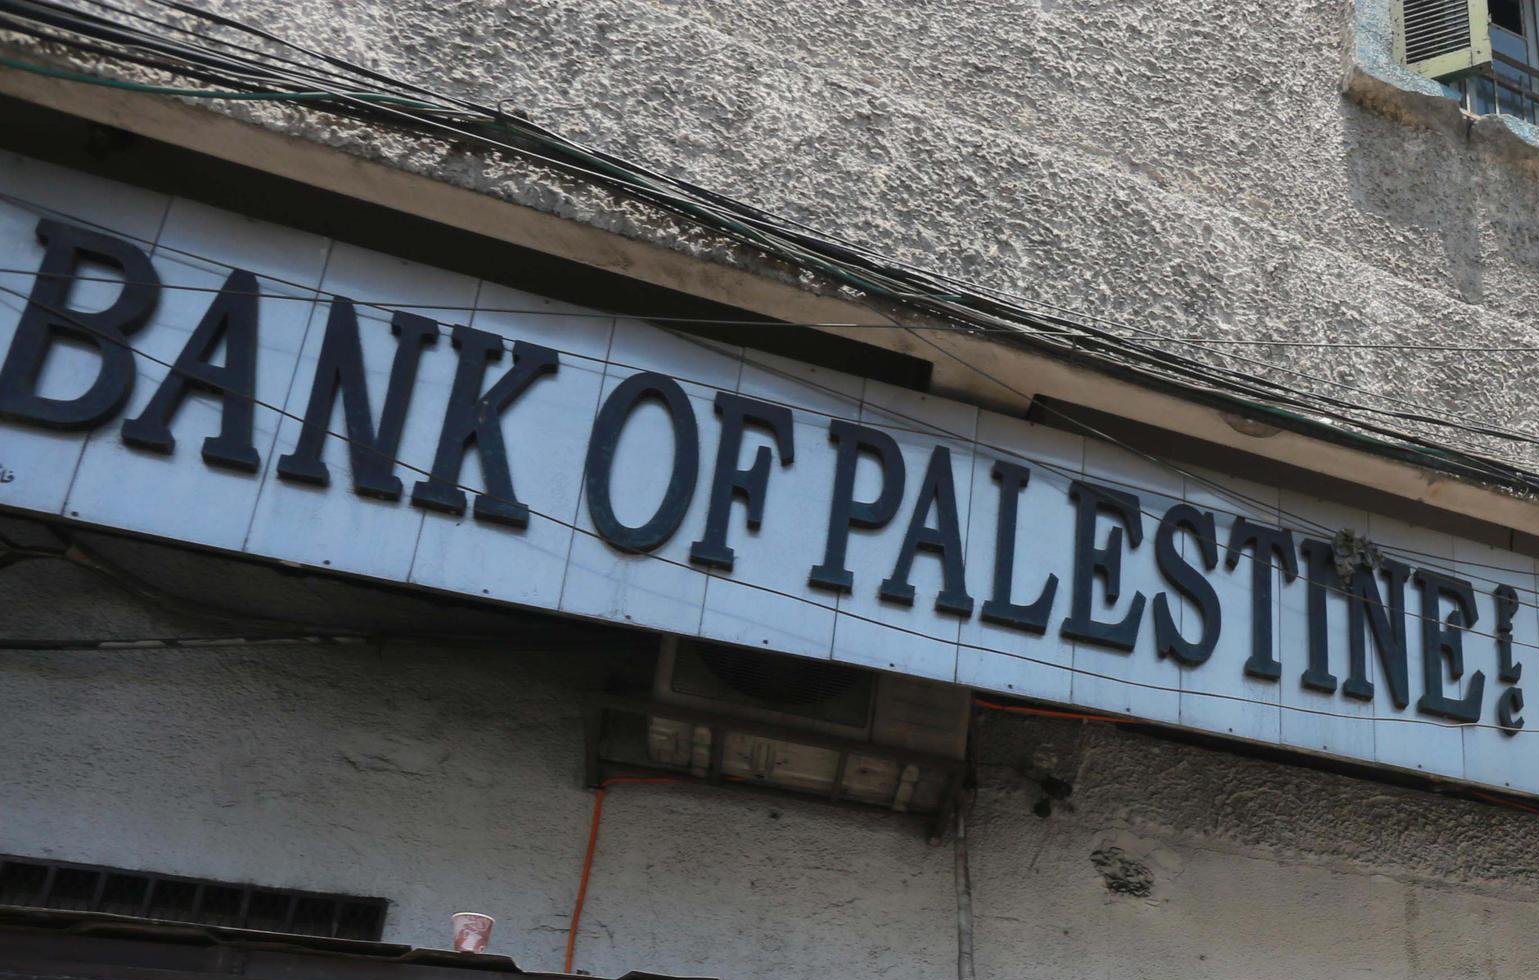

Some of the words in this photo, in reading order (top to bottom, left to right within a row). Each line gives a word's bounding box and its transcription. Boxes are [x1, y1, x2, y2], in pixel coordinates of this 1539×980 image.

[0, 216, 560, 531] BANK
[586, 371, 795, 573] OF
[808, 418, 1485, 725] PALESTINE
